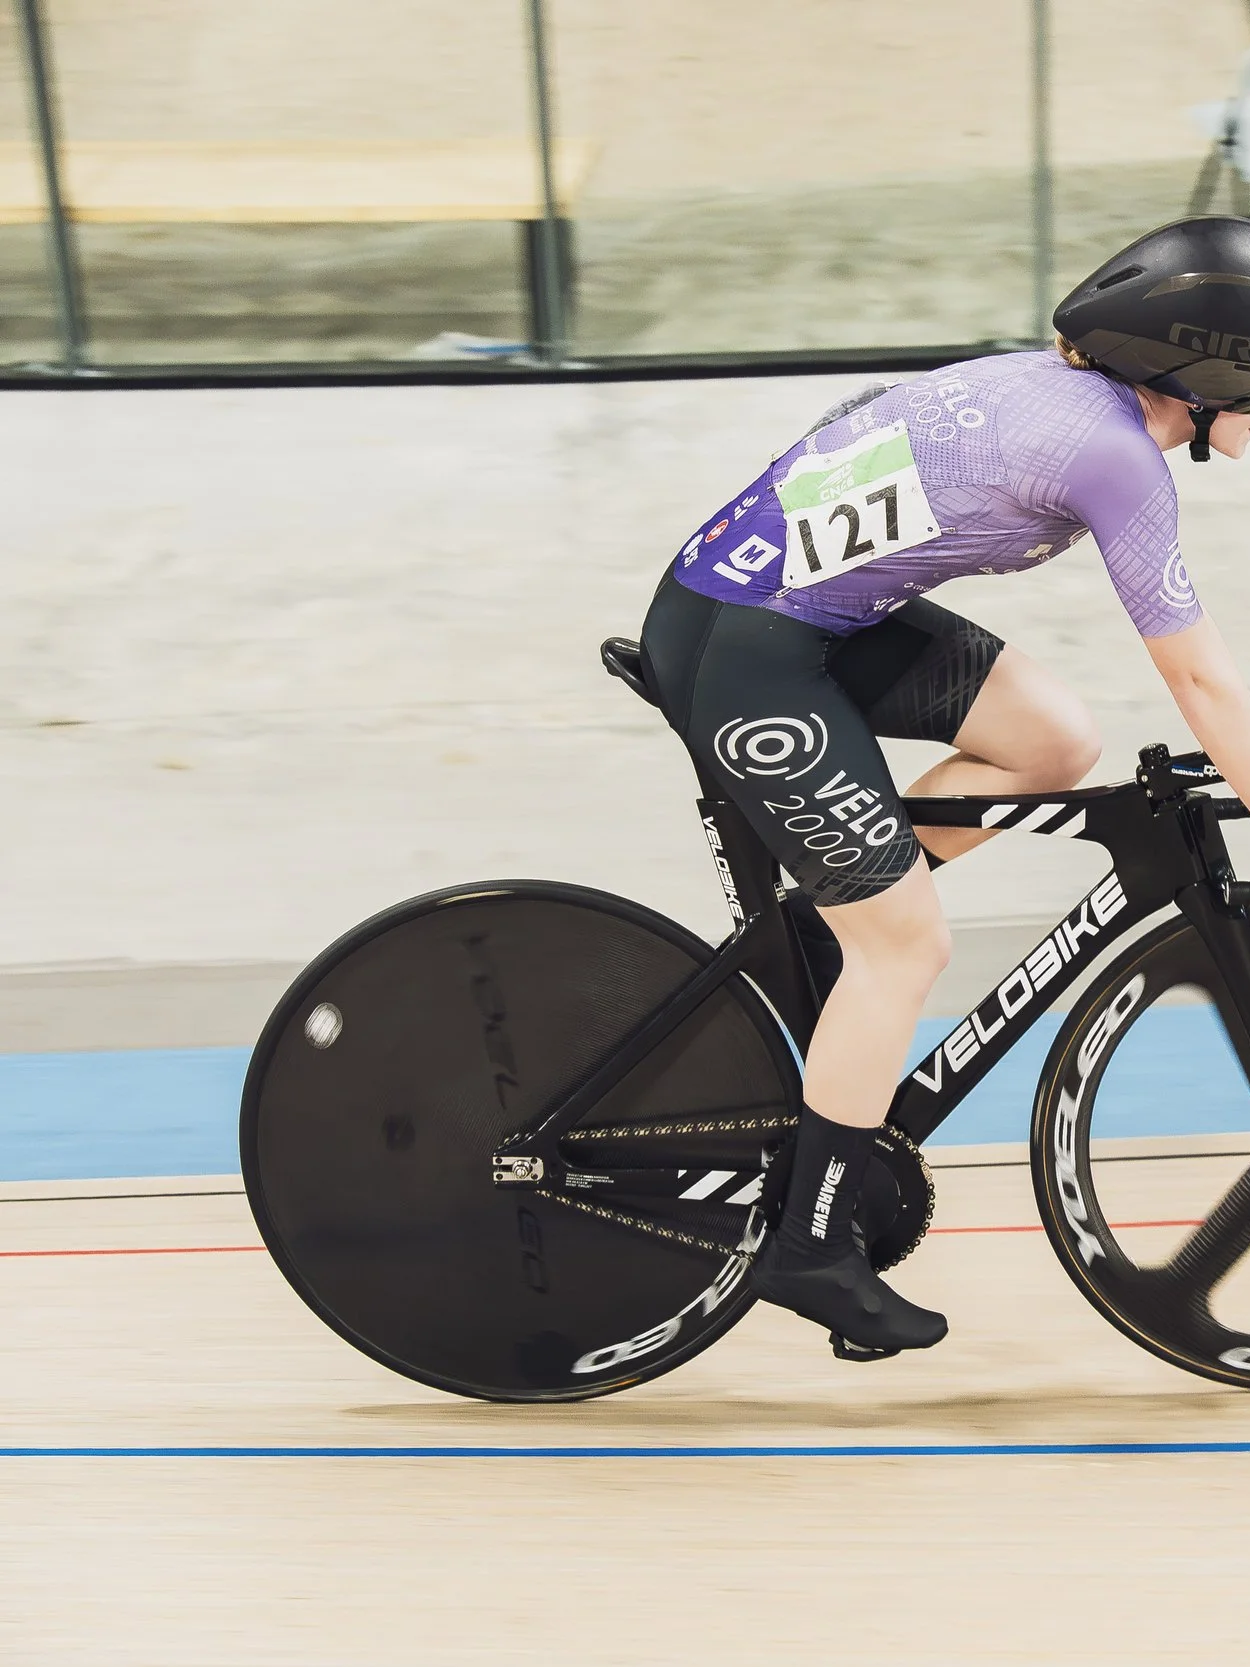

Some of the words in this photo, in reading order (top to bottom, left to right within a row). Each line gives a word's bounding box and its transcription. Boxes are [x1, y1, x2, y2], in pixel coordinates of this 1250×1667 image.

[905, 382, 956, 441] 2000
[797, 483, 899, 573] 127
[763, 795, 862, 867] 2000
[814, 770, 898, 846] VÉLO
[702, 815, 746, 920] VELOBIKE
[912, 872, 1128, 1094] VELOBIKE
[1054, 973, 1146, 1266] YOELEO
[811, 1172, 842, 1241] DAREVIE
